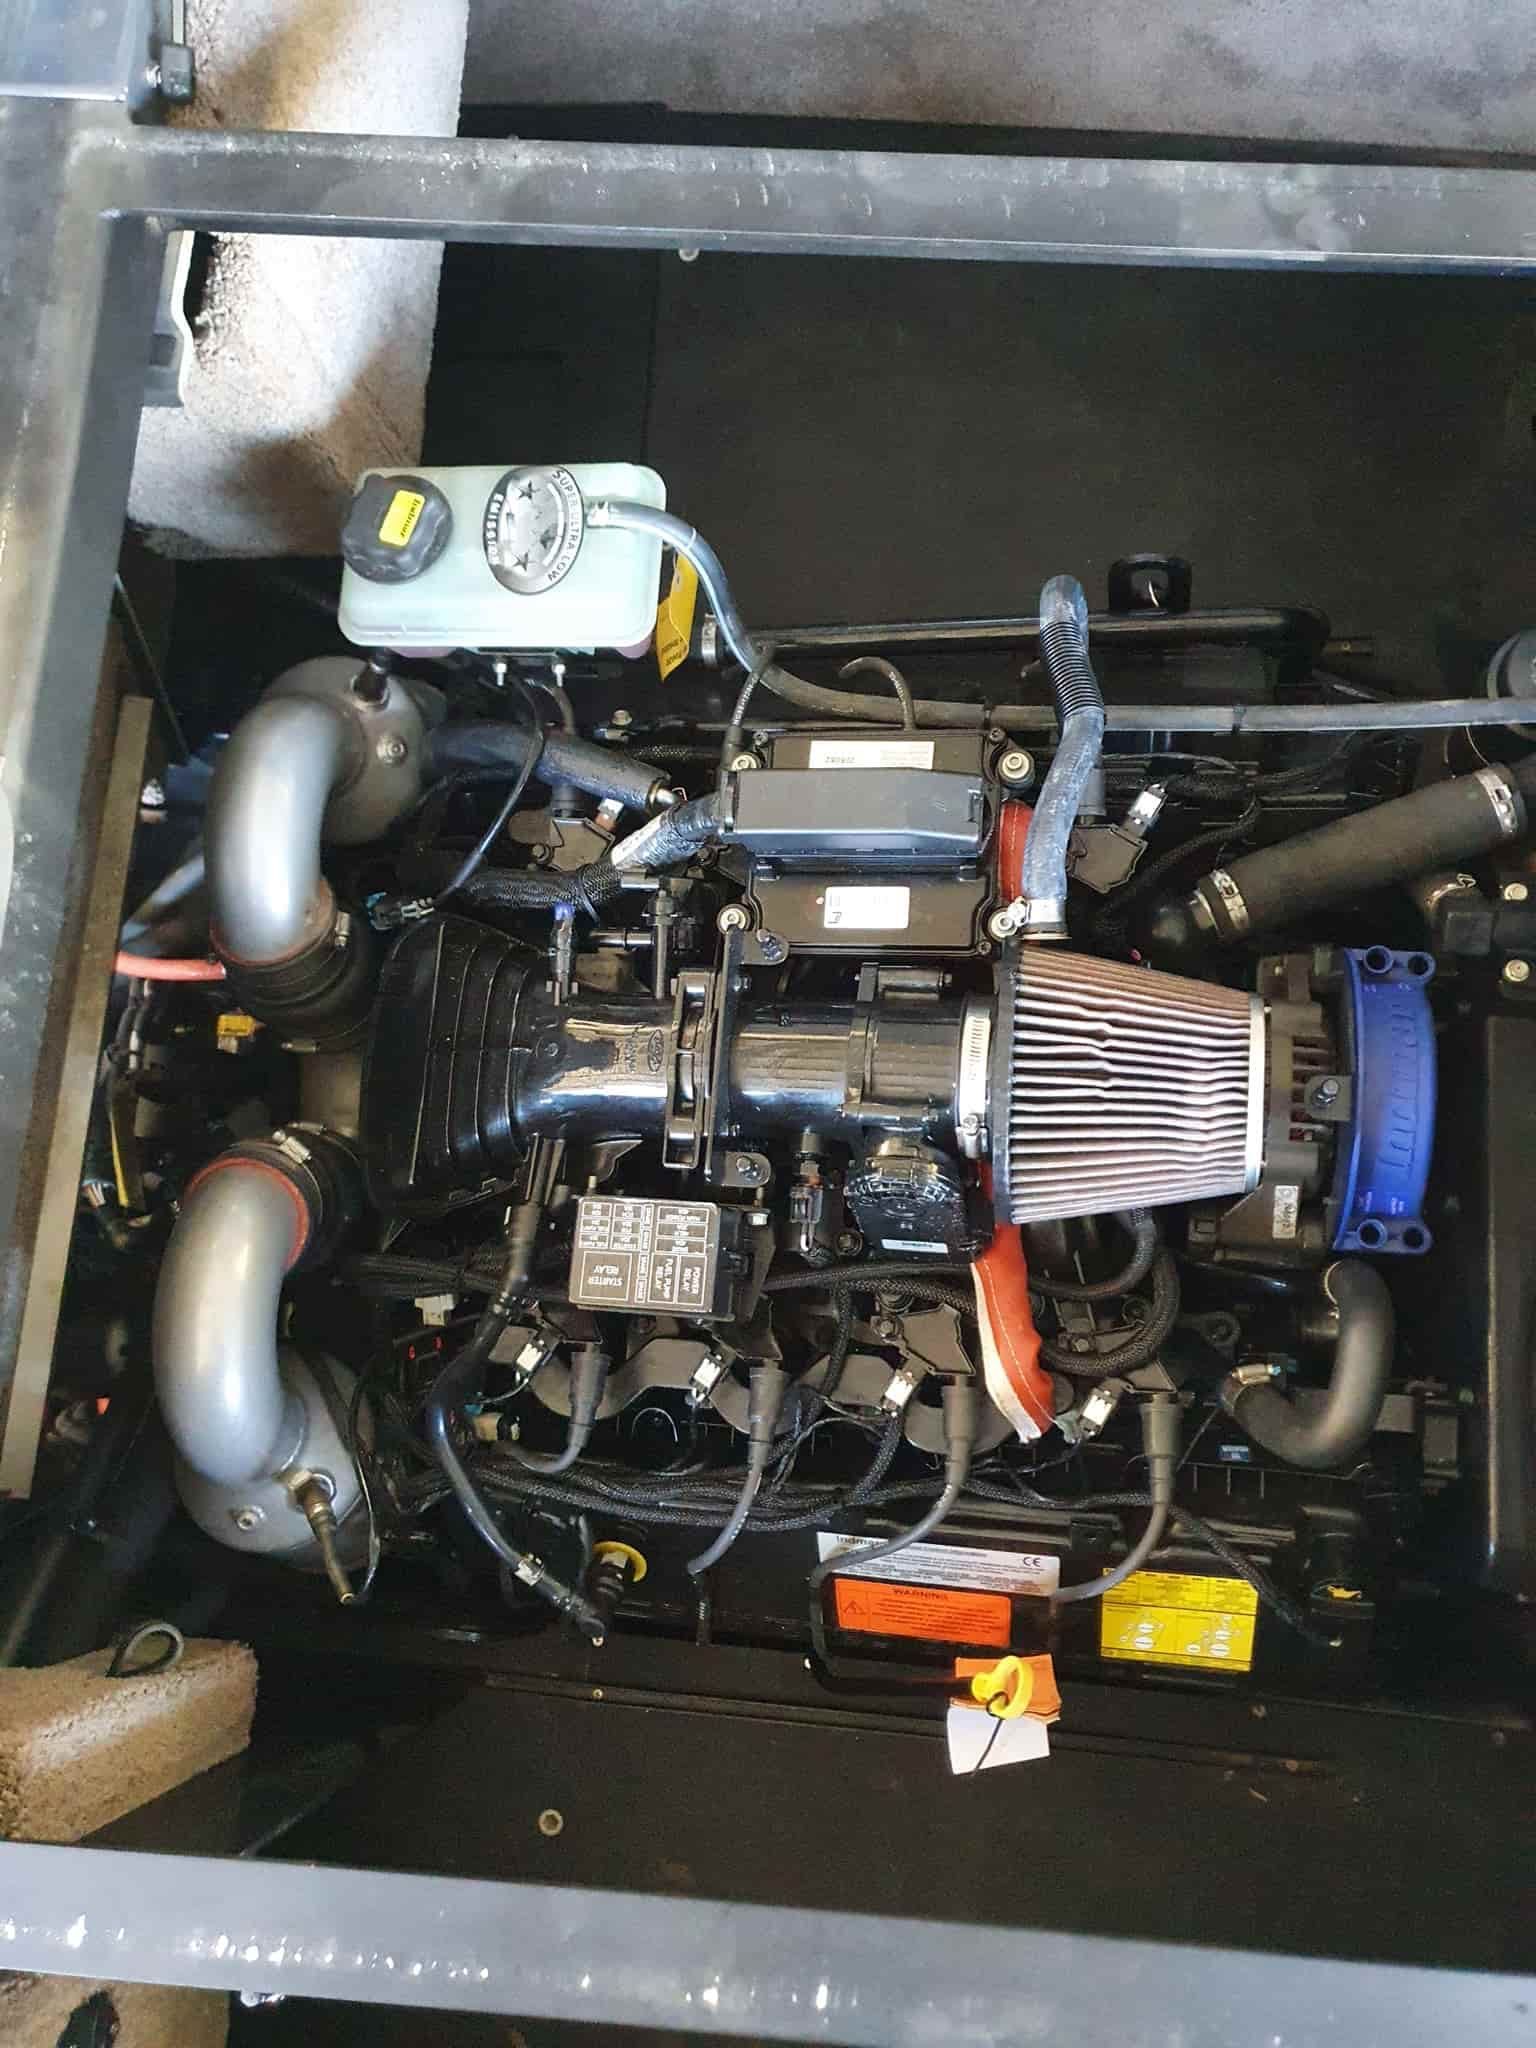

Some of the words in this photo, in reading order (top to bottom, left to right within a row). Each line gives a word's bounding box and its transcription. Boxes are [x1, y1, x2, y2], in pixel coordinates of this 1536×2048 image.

[593, 1264, 620, 1275] RELAY
[587, 1276, 623, 1287] STARTER
[893, 1588, 949, 1601] WARNING
